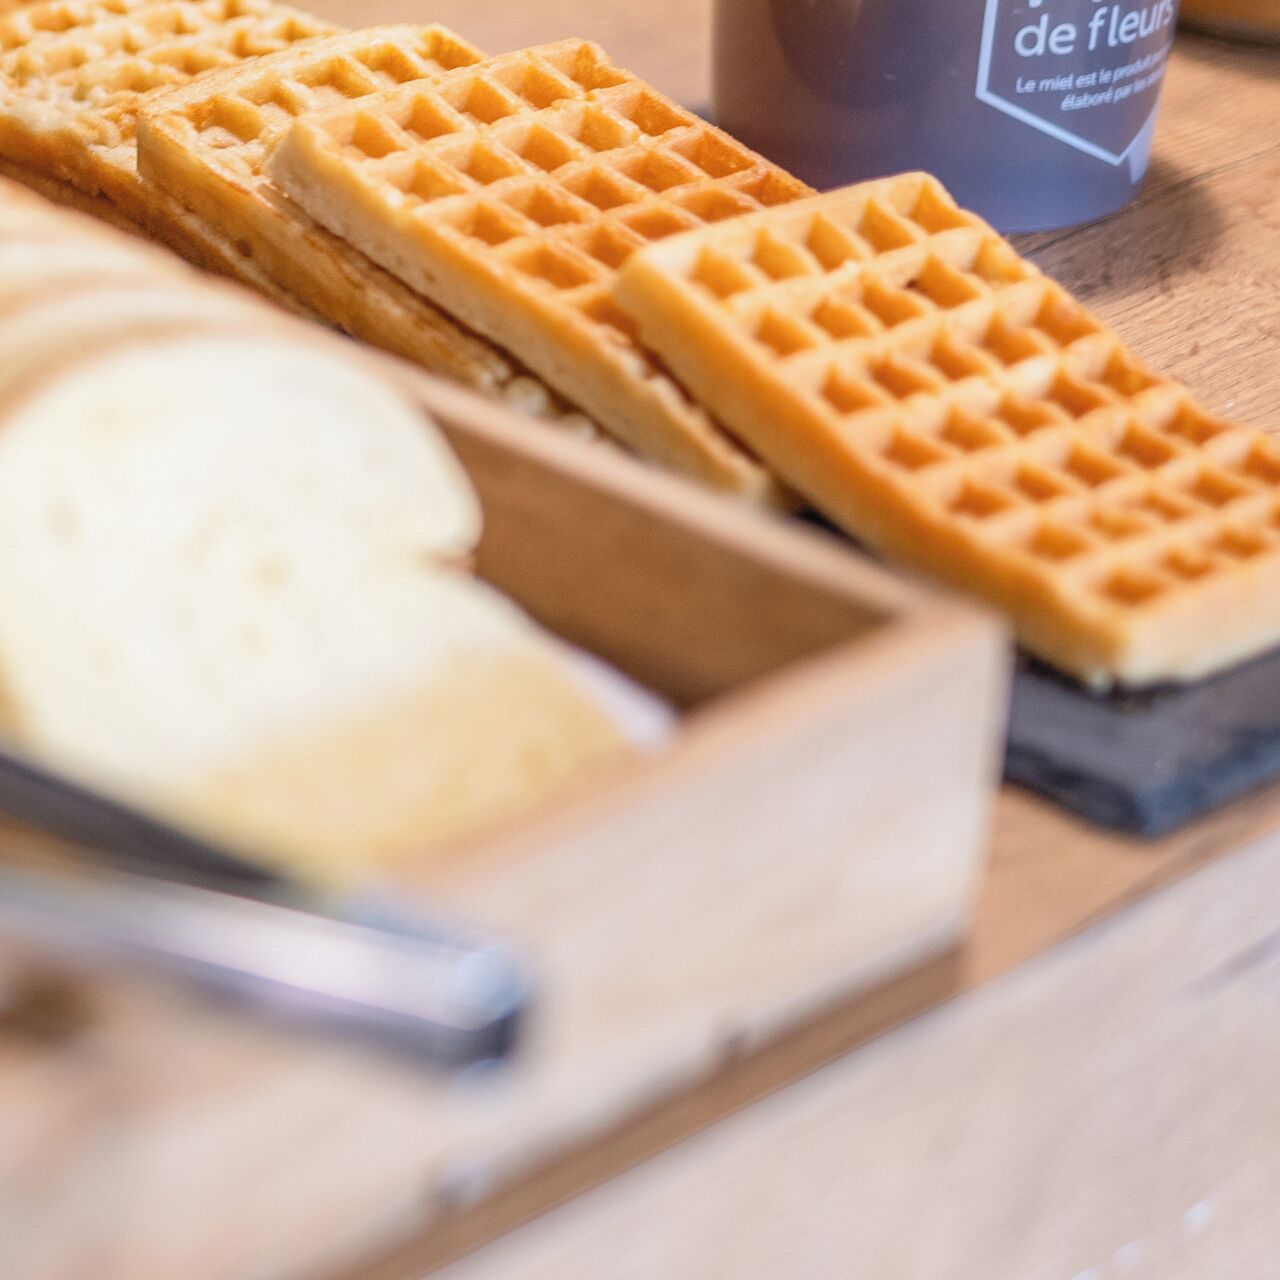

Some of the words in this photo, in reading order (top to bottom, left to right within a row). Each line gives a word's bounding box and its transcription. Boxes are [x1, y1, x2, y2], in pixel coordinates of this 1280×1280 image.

[1014, 13, 1077, 57] de
[1015, 76, 1036, 93] Le
[1038, 73, 1073, 92] miel
